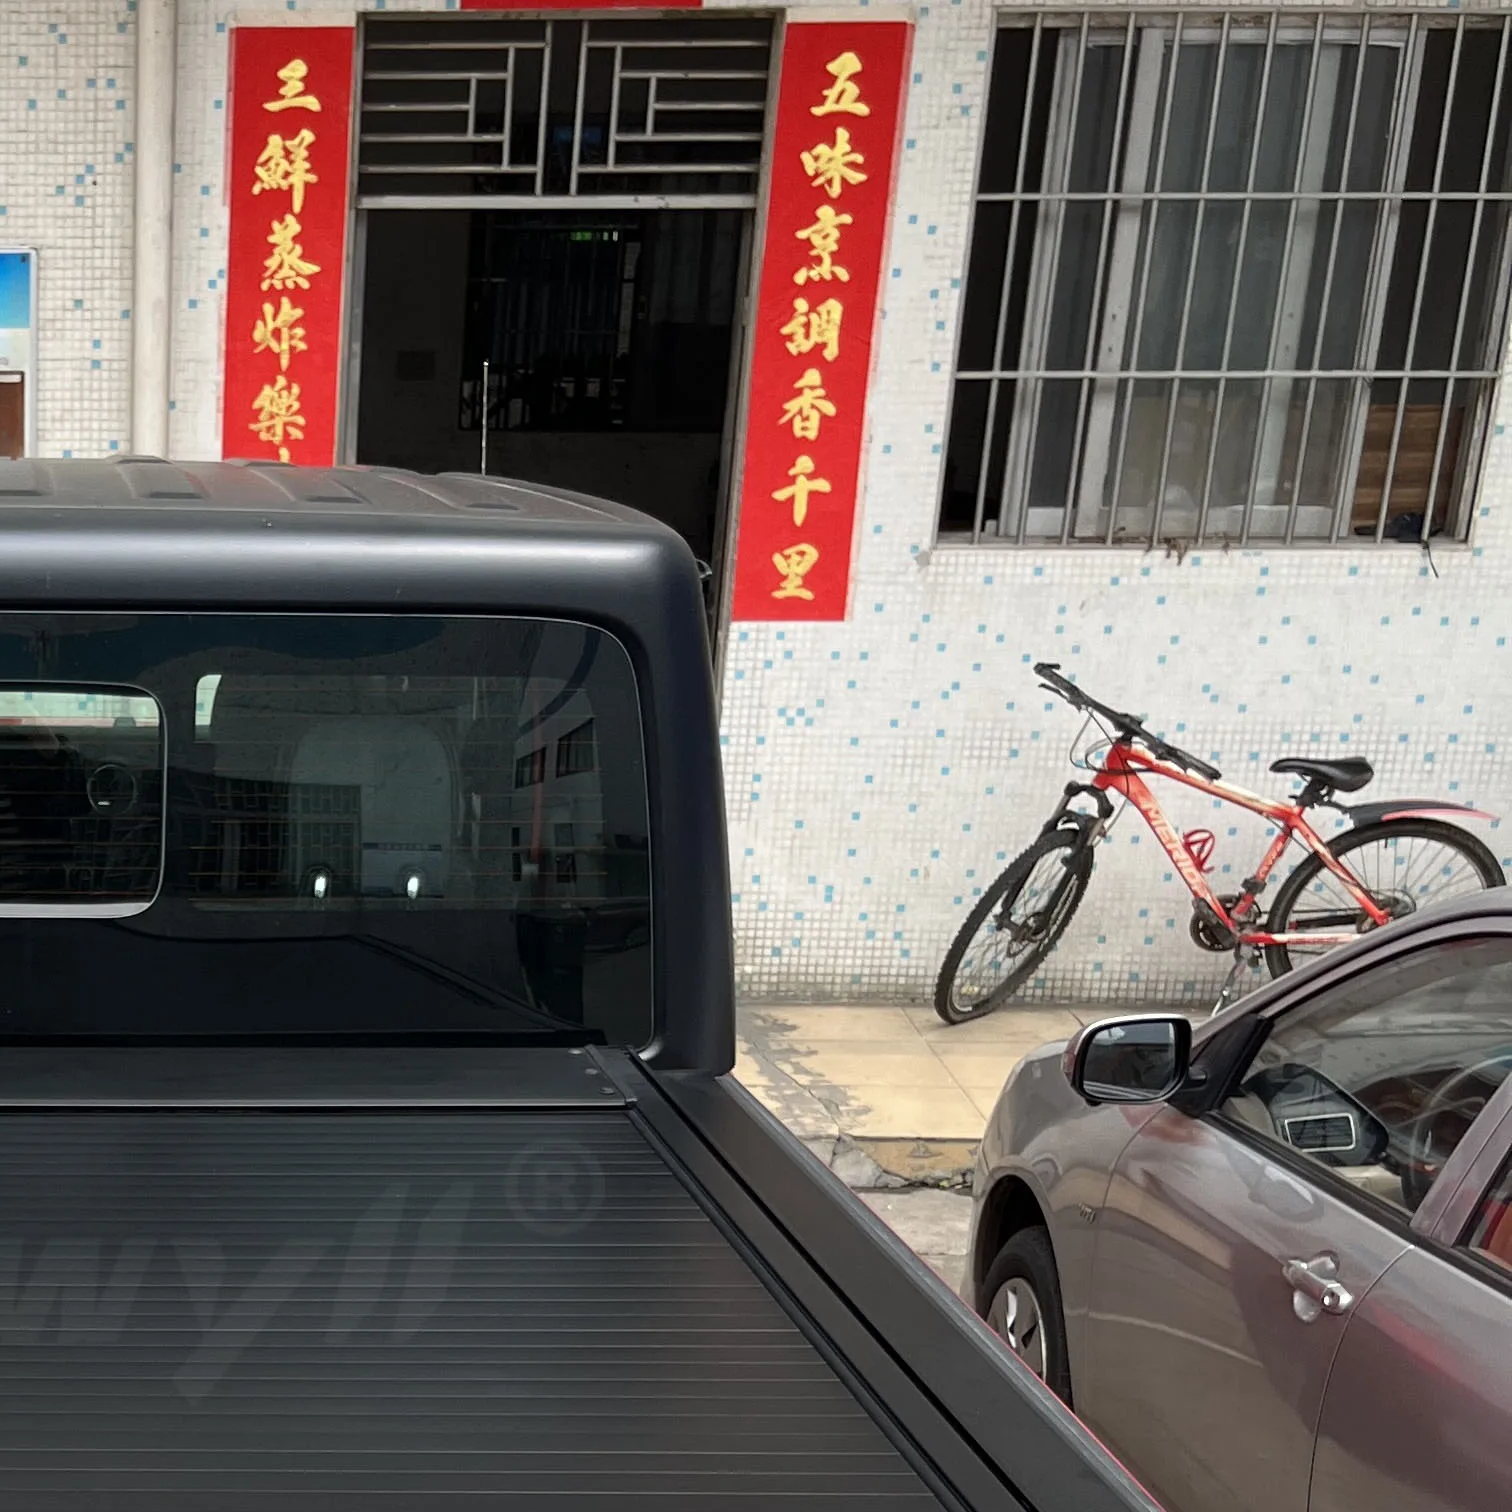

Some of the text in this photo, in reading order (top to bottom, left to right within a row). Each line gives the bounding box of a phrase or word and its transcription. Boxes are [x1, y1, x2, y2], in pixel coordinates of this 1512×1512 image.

[249, 58, 322, 463] 三鮮蒸炸樂
